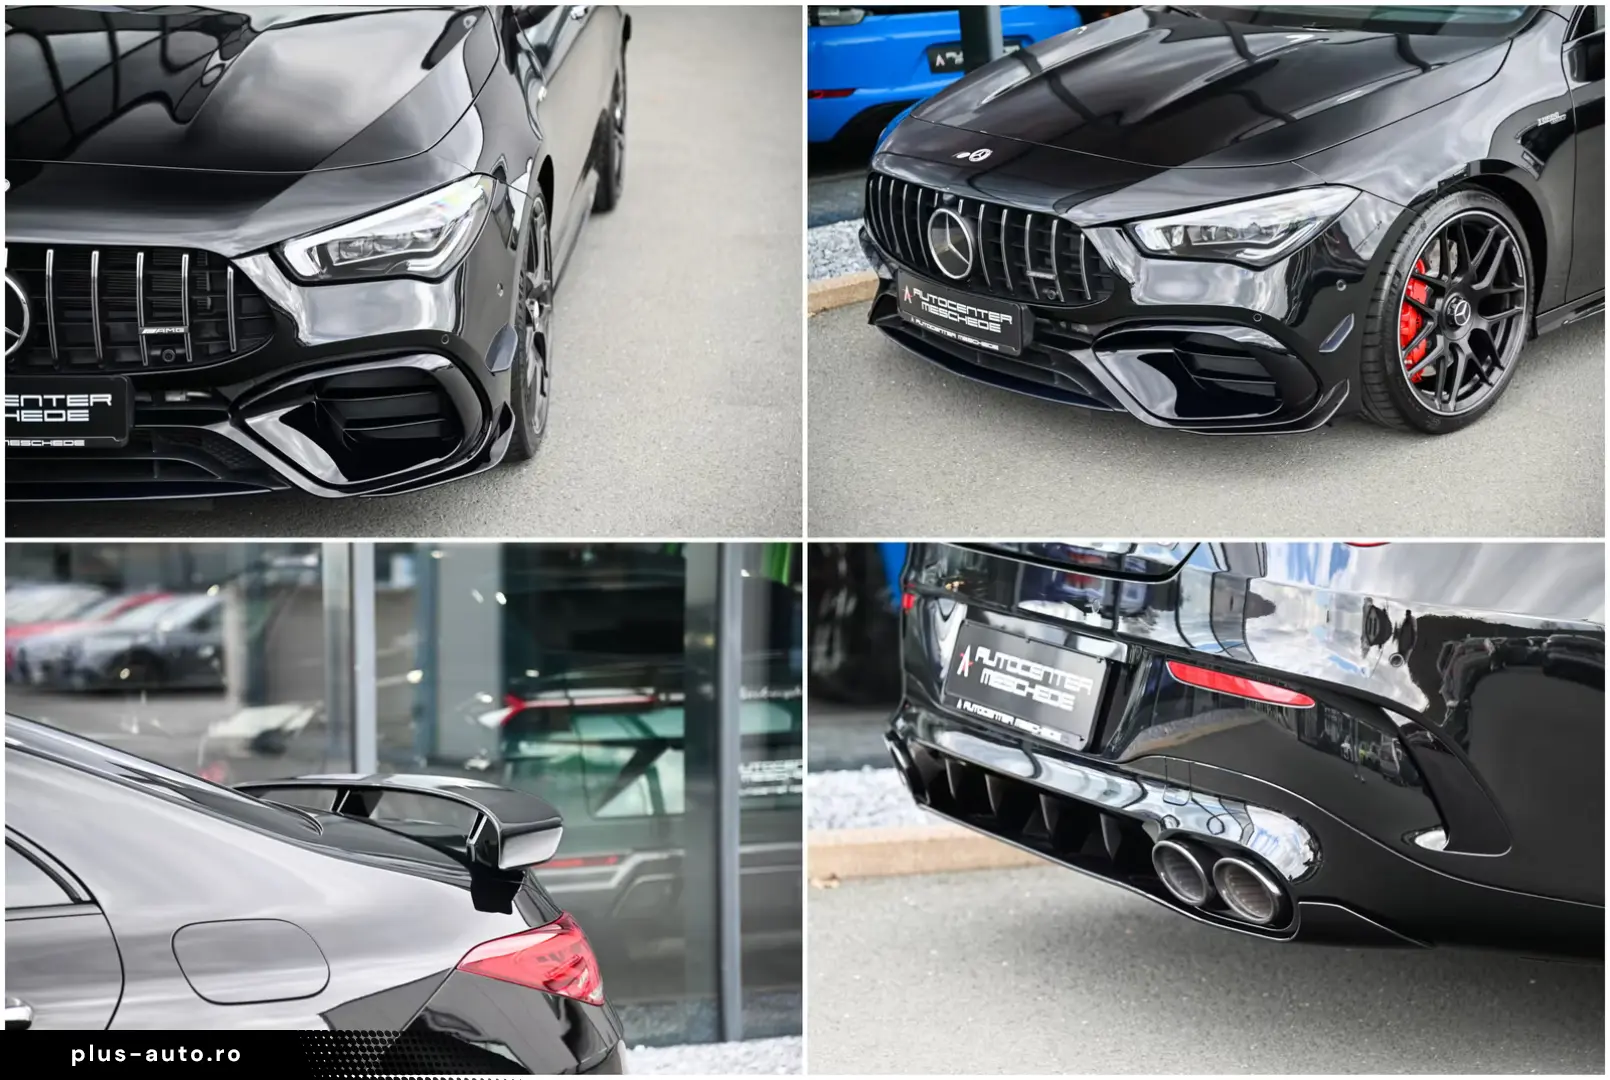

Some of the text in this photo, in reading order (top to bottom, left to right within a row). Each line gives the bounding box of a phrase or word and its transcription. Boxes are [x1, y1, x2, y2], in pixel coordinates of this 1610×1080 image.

[913, 288, 1012, 325] AUTOCENTER
[921, 302, 1002, 333] MESCHEDE
[974, 646, 1094, 696] AUTOCENTER
[980, 668, 1076, 712] MESCHEDE
